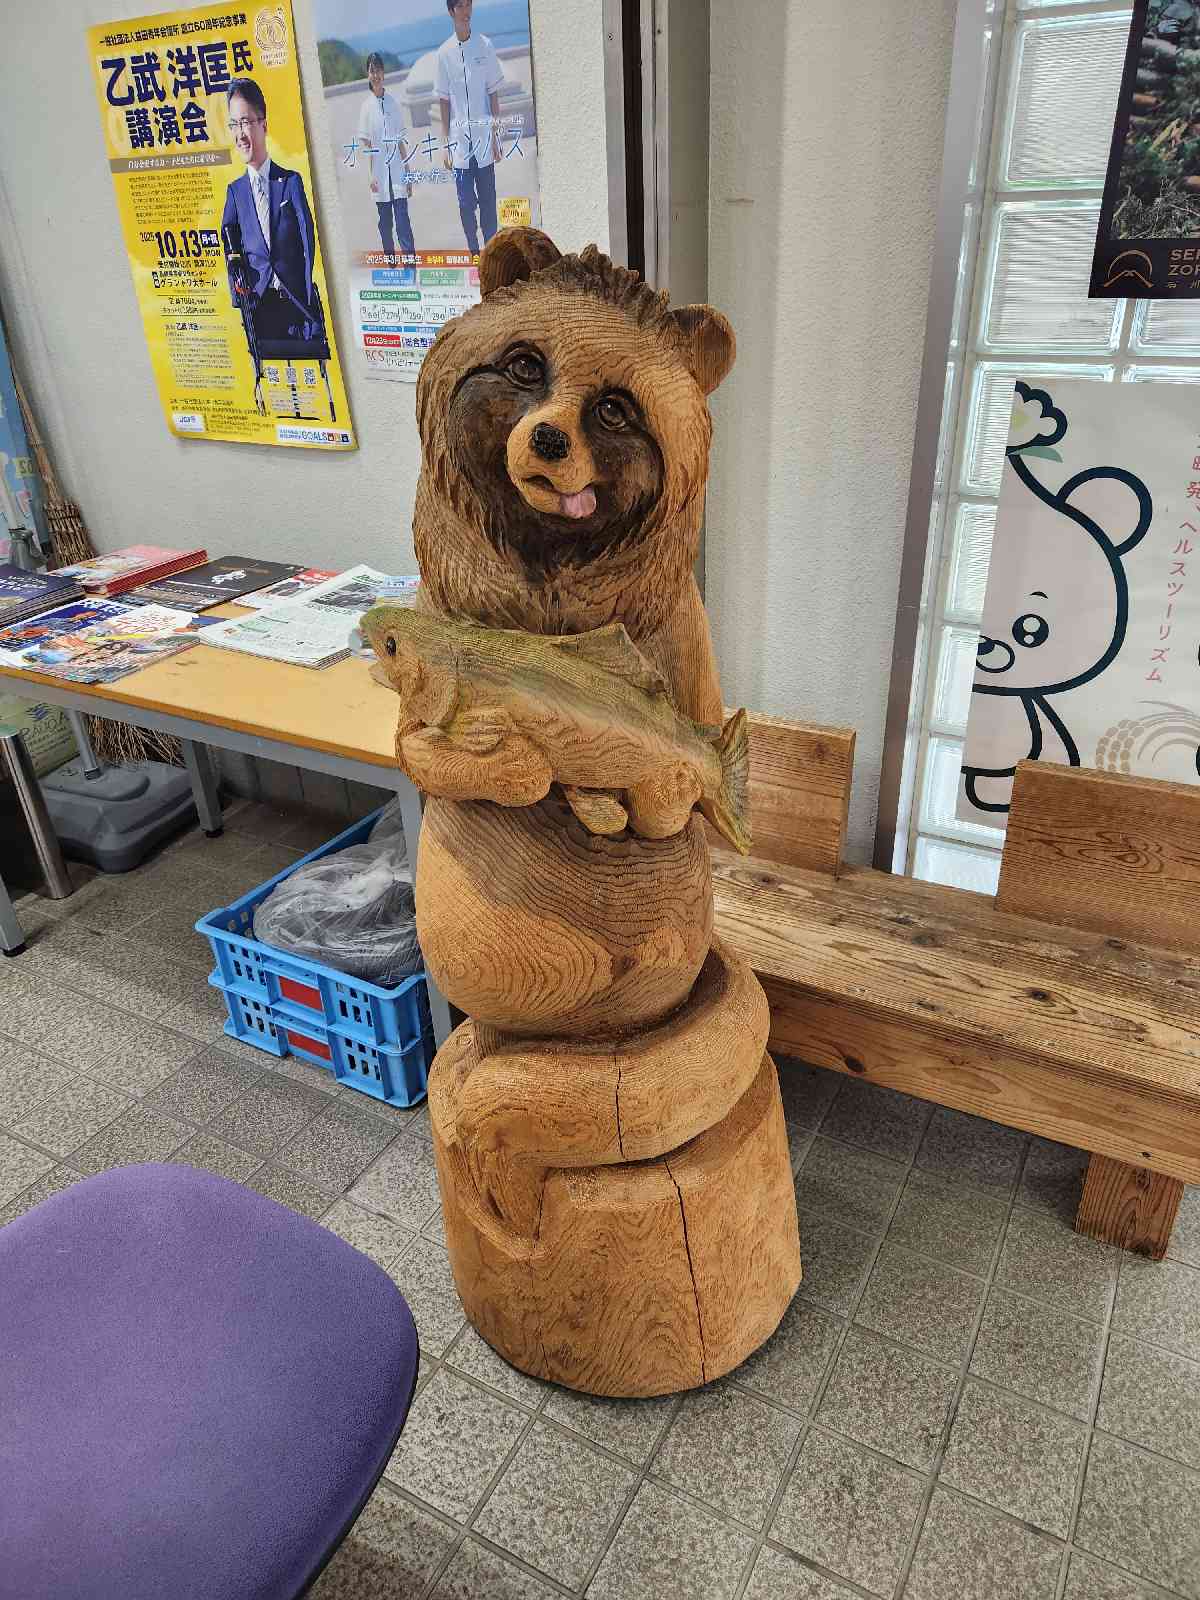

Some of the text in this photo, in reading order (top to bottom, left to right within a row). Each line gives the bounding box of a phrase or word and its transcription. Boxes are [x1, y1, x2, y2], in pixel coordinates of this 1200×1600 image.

[125, 101, 210, 149] 講演会
[343, 127, 526, 168] オープンキャンパス
[155, 229, 203, 259] 10.13
[386, 358, 421, 367] リハビリテー
